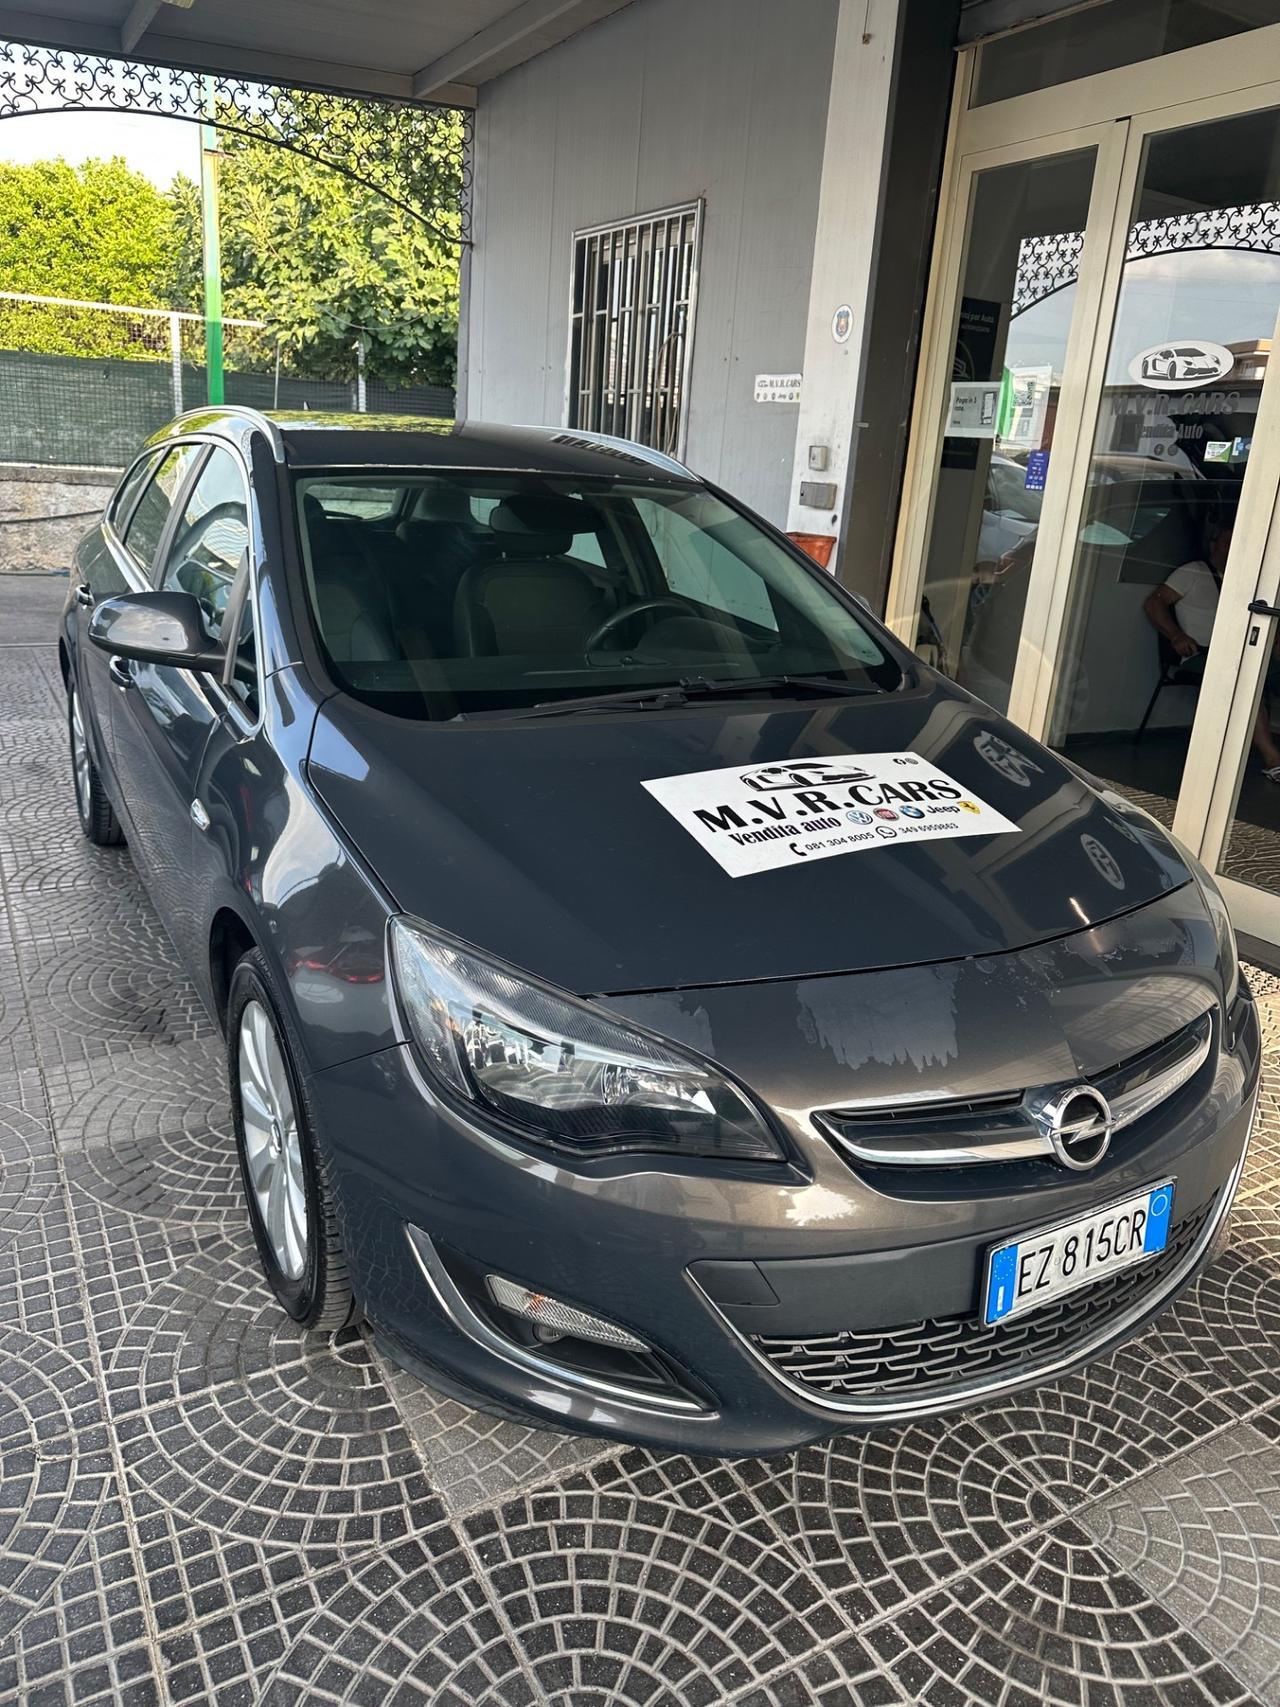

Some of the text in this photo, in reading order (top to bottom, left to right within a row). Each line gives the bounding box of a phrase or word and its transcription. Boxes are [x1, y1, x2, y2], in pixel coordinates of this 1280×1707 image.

[1135, 423, 1203, 439] endita Auto
[926, 805, 960, 814] Jeep
[728, 816, 842, 846] Vendita auto
[804, 841, 825, 851] 081
[828, 837, 847, 847] 304
[849, 832, 875, 843] 8005
[1018, 1209, 1147, 1297] EZ 815CR
